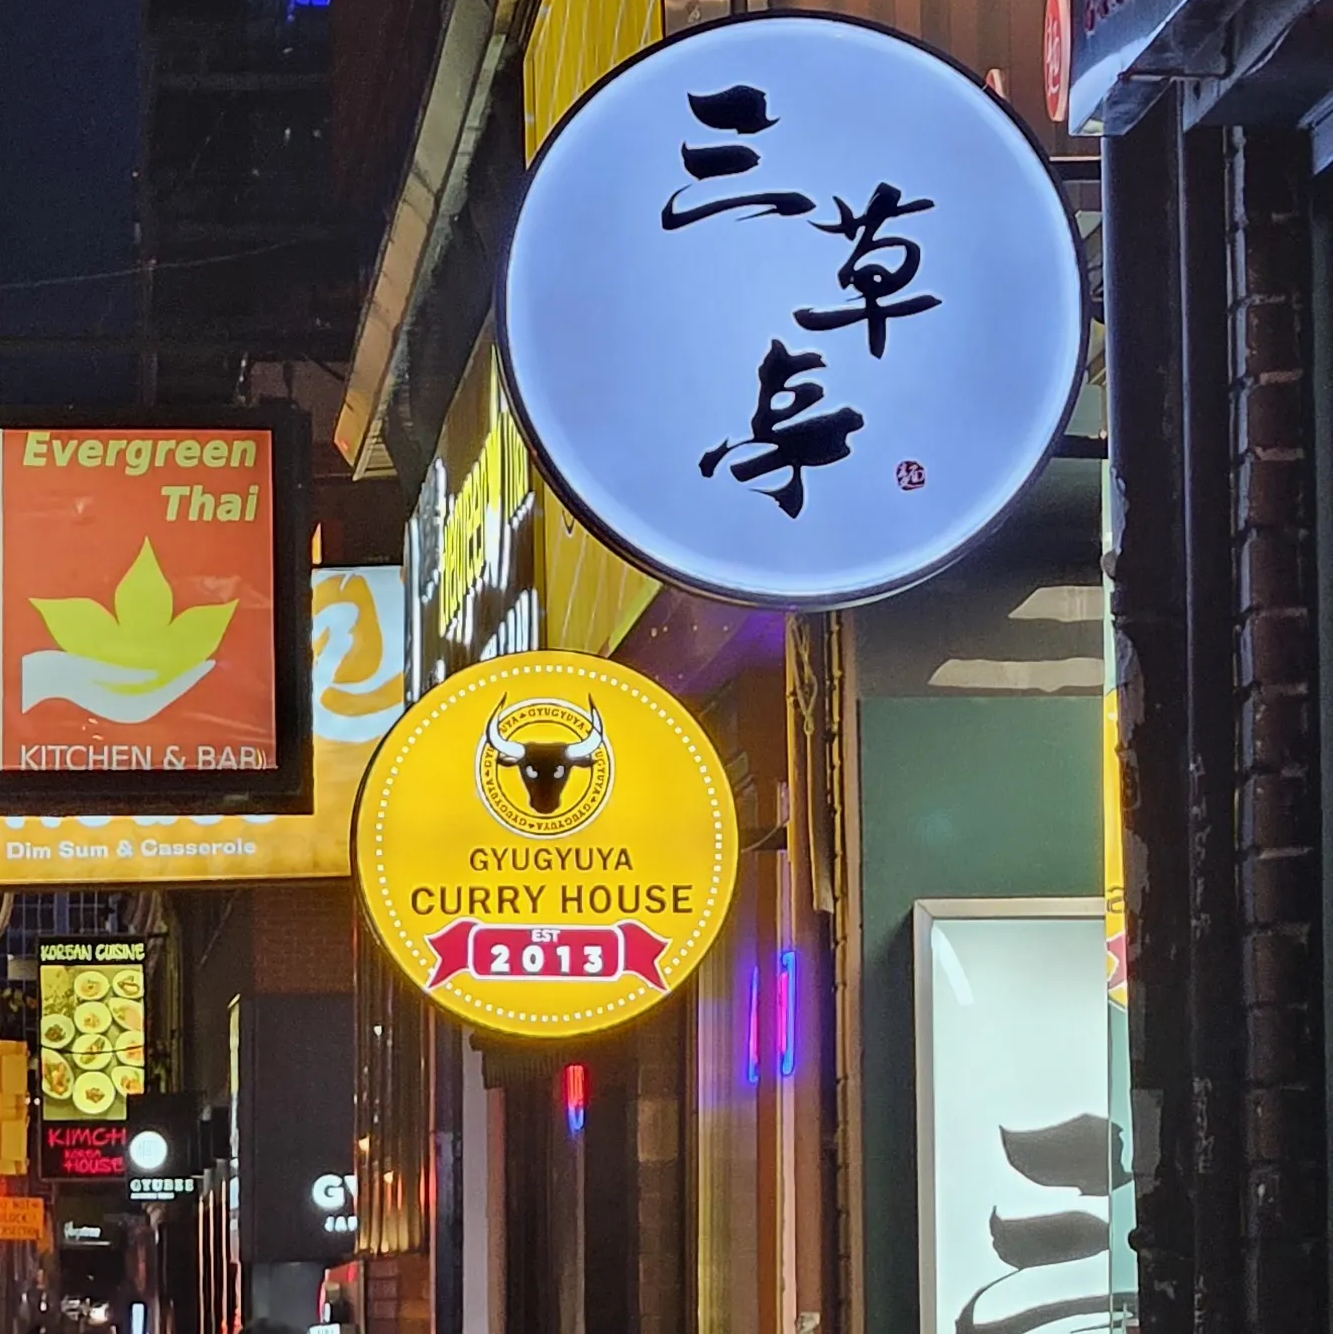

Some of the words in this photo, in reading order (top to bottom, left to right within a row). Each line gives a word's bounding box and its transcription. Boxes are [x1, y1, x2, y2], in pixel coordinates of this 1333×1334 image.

[23, 431, 257, 476] Evergreen
[160, 485, 260, 522] Thai
[20, 744, 152, 771] KITCHEN
[163, 744, 186, 770] &
[197, 745, 257, 771] BAR
[6, 841, 51, 859] Dim
[59, 840, 109, 859] Sum
[117, 840, 134, 857] &
[141, 838, 257, 857] Casserole
[469, 847, 634, 872] GYUGYUYA
[410, 884, 546, 915] CURRY
[561, 883, 694, 914] HOUSE
[531, 929, 561, 944] EST
[40, 944, 92, 961] KOREAN
[95, 943, 145, 961] CUISINE
[490, 946, 604, 974] 2013
[47, 1127, 127, 1147] KIMCH
[62, 1157, 124, 1173] HOUSE
